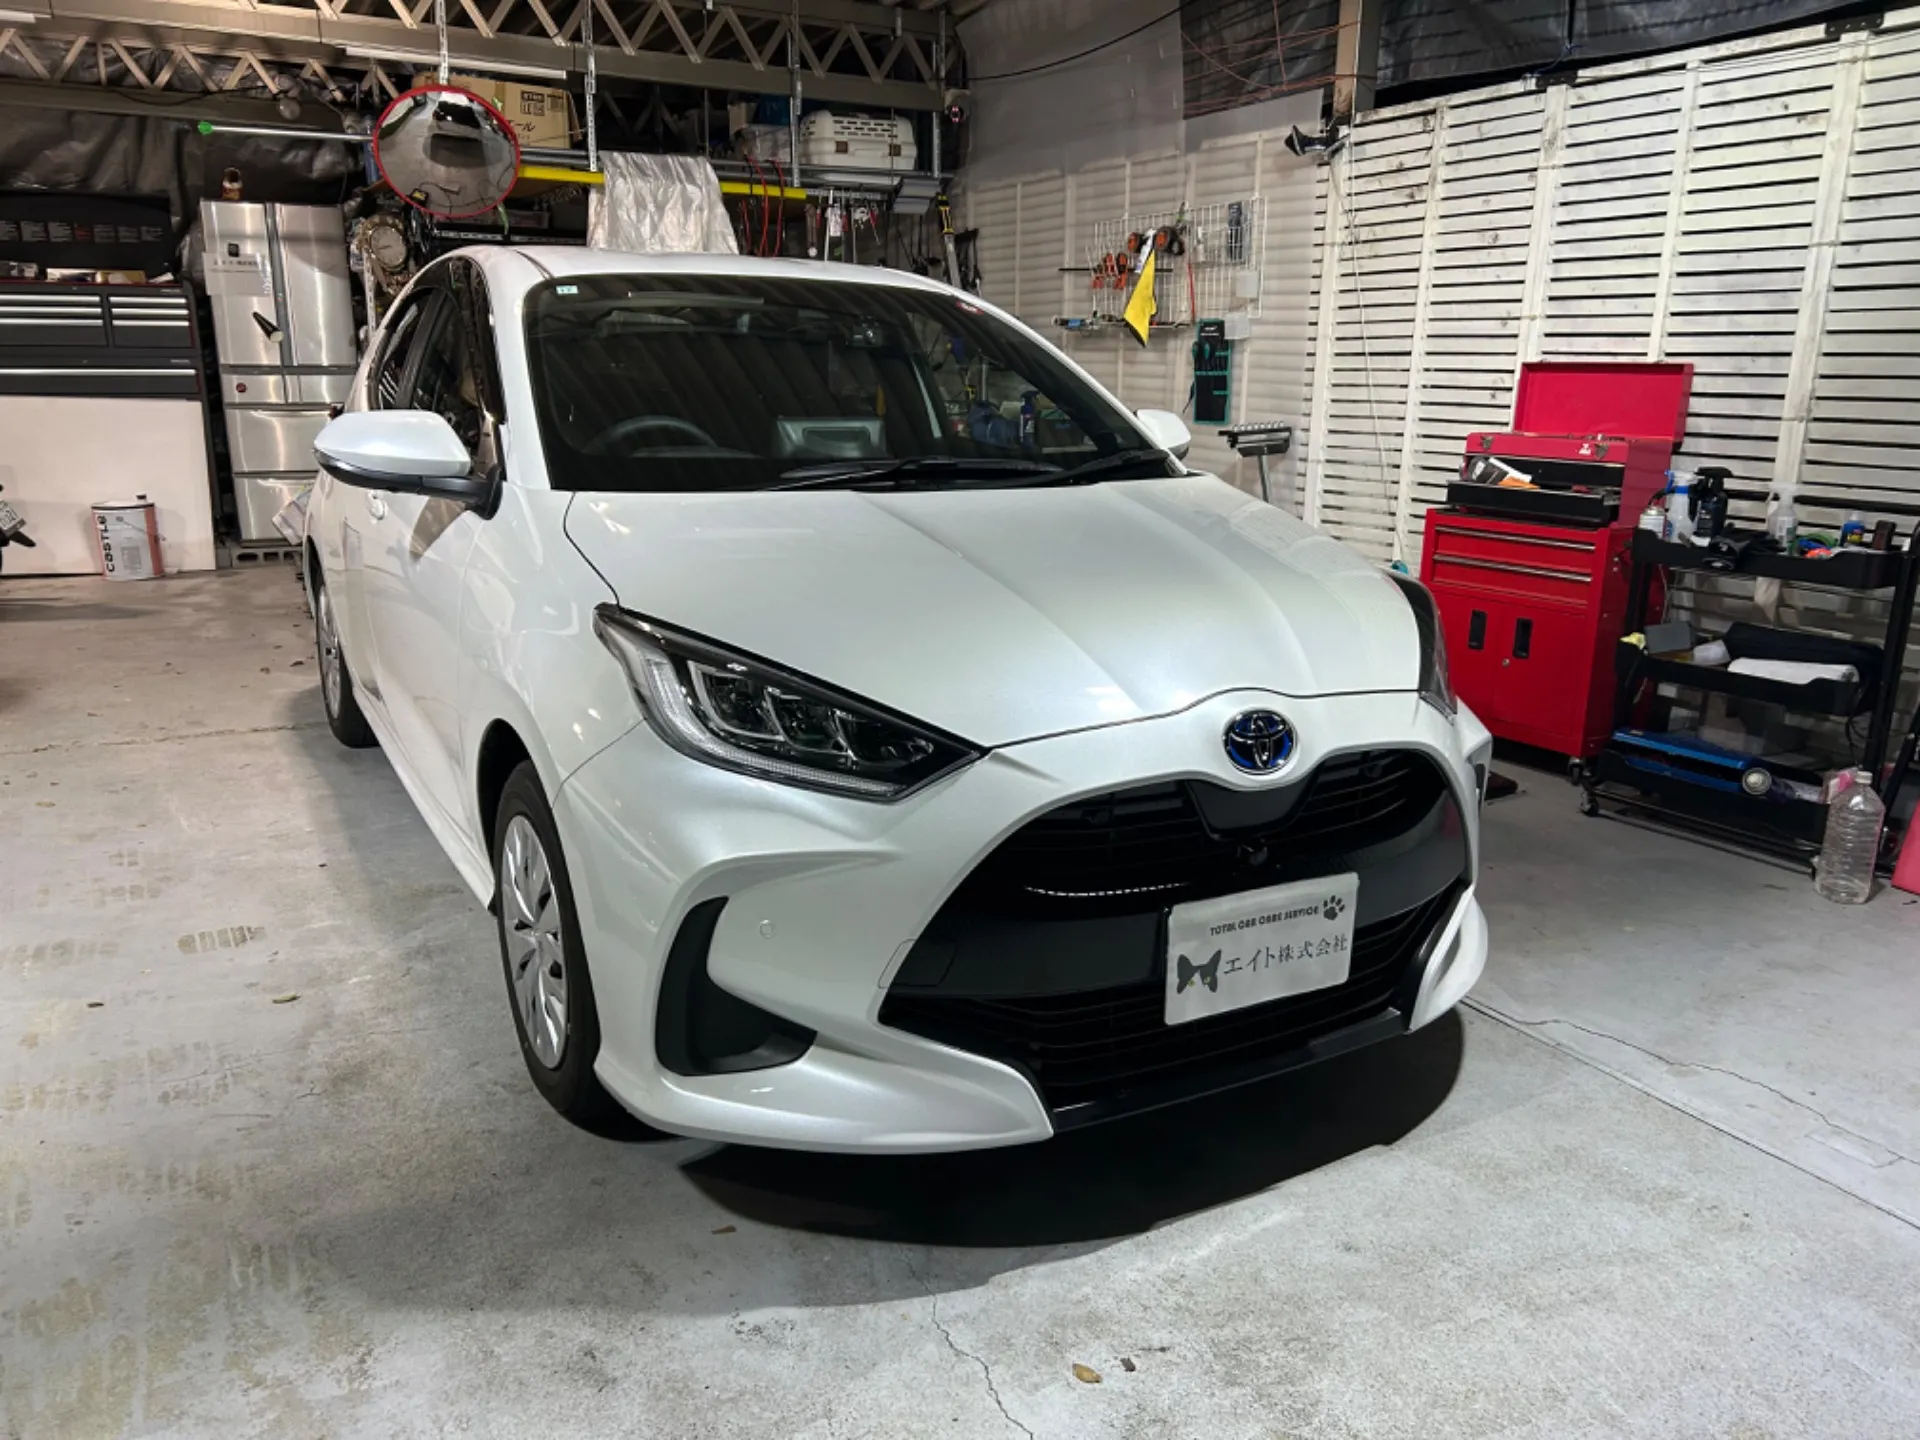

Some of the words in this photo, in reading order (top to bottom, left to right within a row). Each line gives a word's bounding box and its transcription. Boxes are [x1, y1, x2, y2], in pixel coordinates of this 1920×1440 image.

[1238, 917, 1257, 930] CAR
[1284, 906, 1319, 920] SERVICE
[1224, 934, 1348, 974] エイト株式会社
